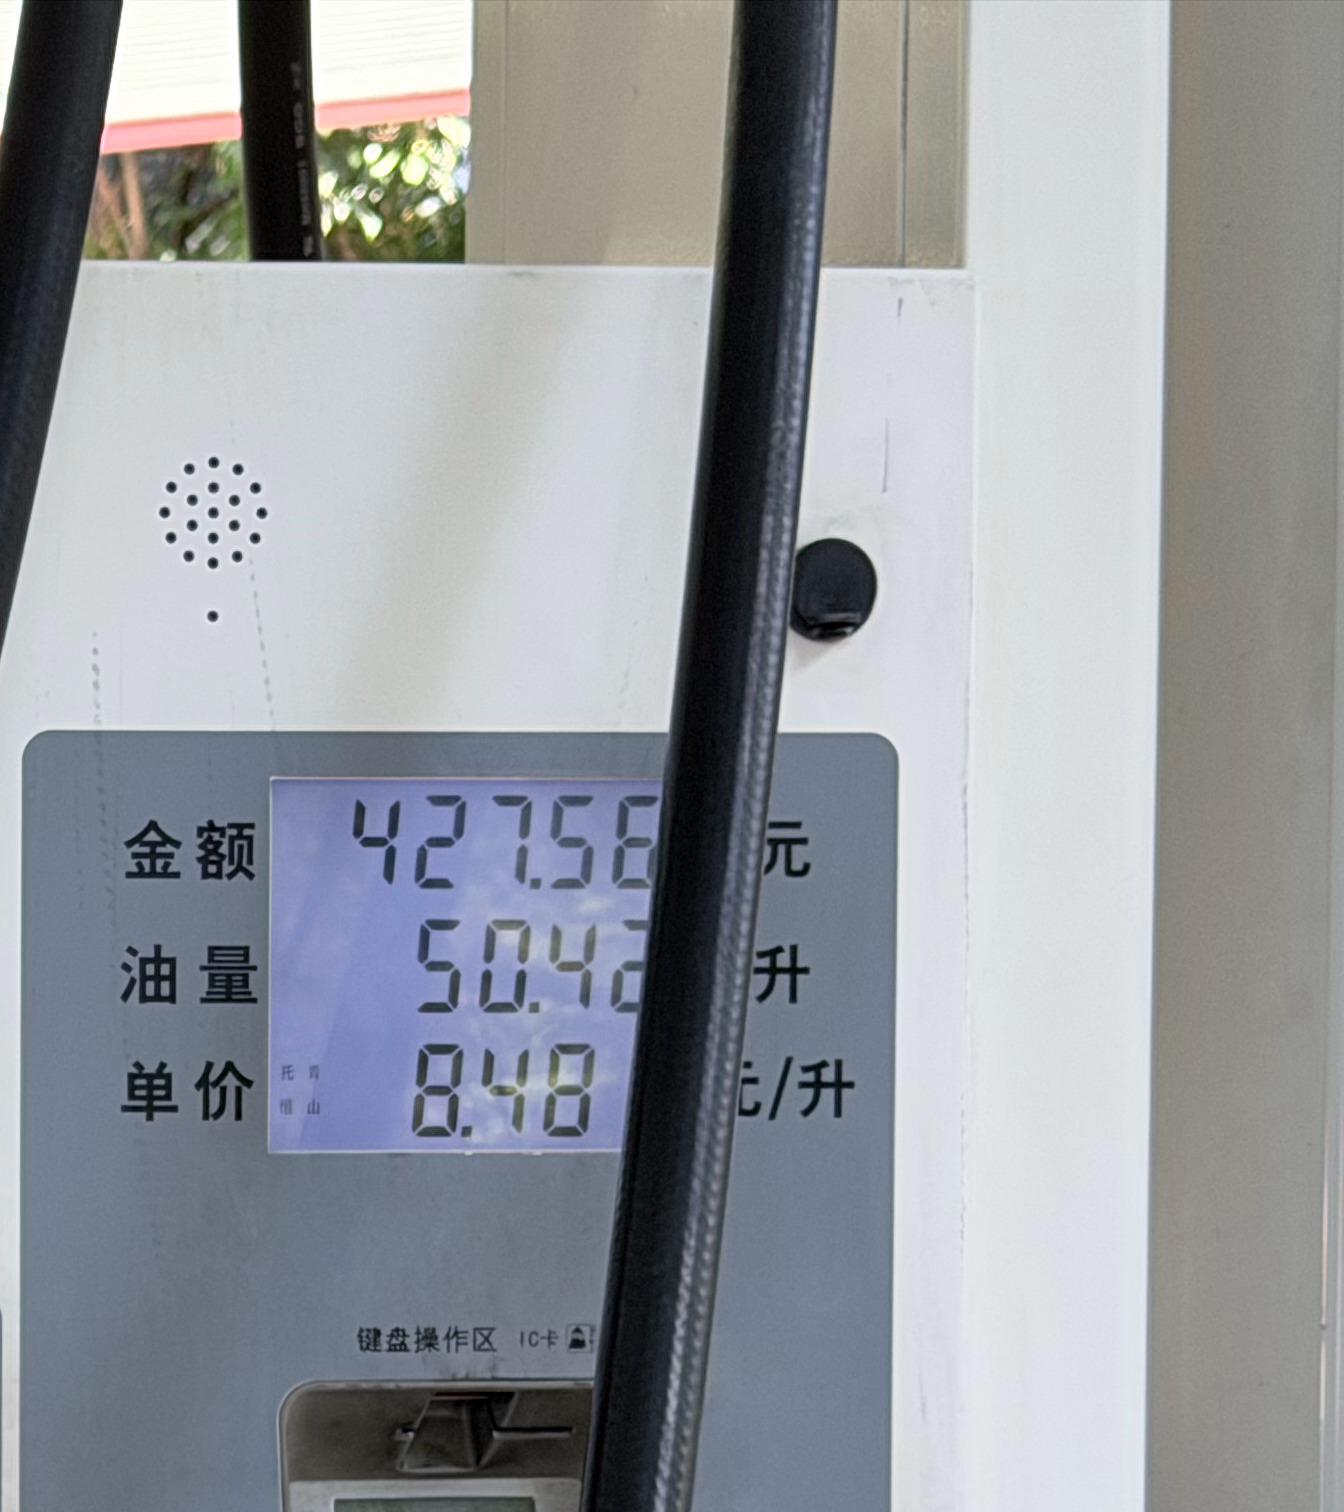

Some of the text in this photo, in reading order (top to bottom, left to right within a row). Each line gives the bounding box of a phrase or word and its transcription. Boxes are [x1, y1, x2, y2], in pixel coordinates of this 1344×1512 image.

[124, 820, 256, 881] 金额
[352, 795, 659, 889] 427.56
[764, 821, 811, 877] 元
[120, 944, 258, 1004] 油量
[753, 944, 810, 1004] 升
[121, 1060, 255, 1122] 单价
[412, 1043, 595, 1138] 8.48
[357, 1326, 559, 1353] 键盘操作区 IC卡
